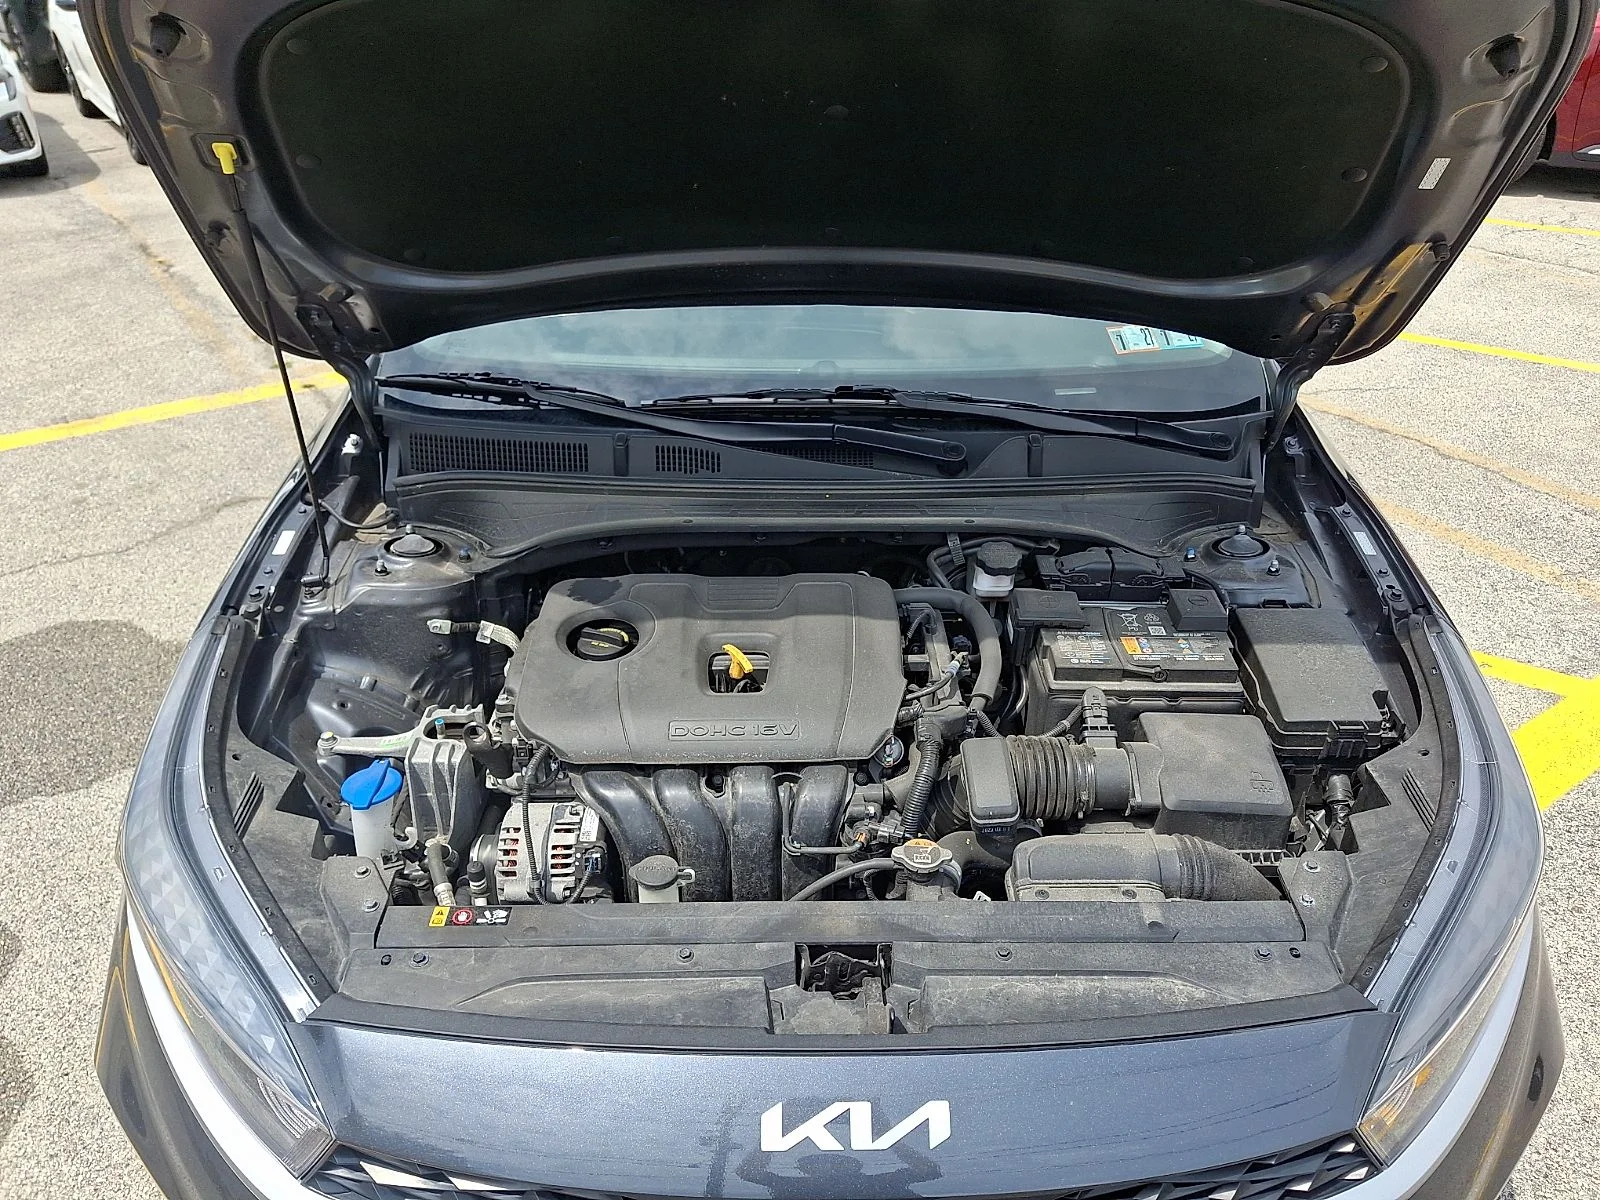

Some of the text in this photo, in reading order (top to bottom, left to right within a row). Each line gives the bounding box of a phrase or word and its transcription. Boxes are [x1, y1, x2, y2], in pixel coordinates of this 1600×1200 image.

[1140, 328, 1154, 346] 27
[670, 723, 798, 737] DOHC 16V
[760, 1100, 951, 1152] KIA
